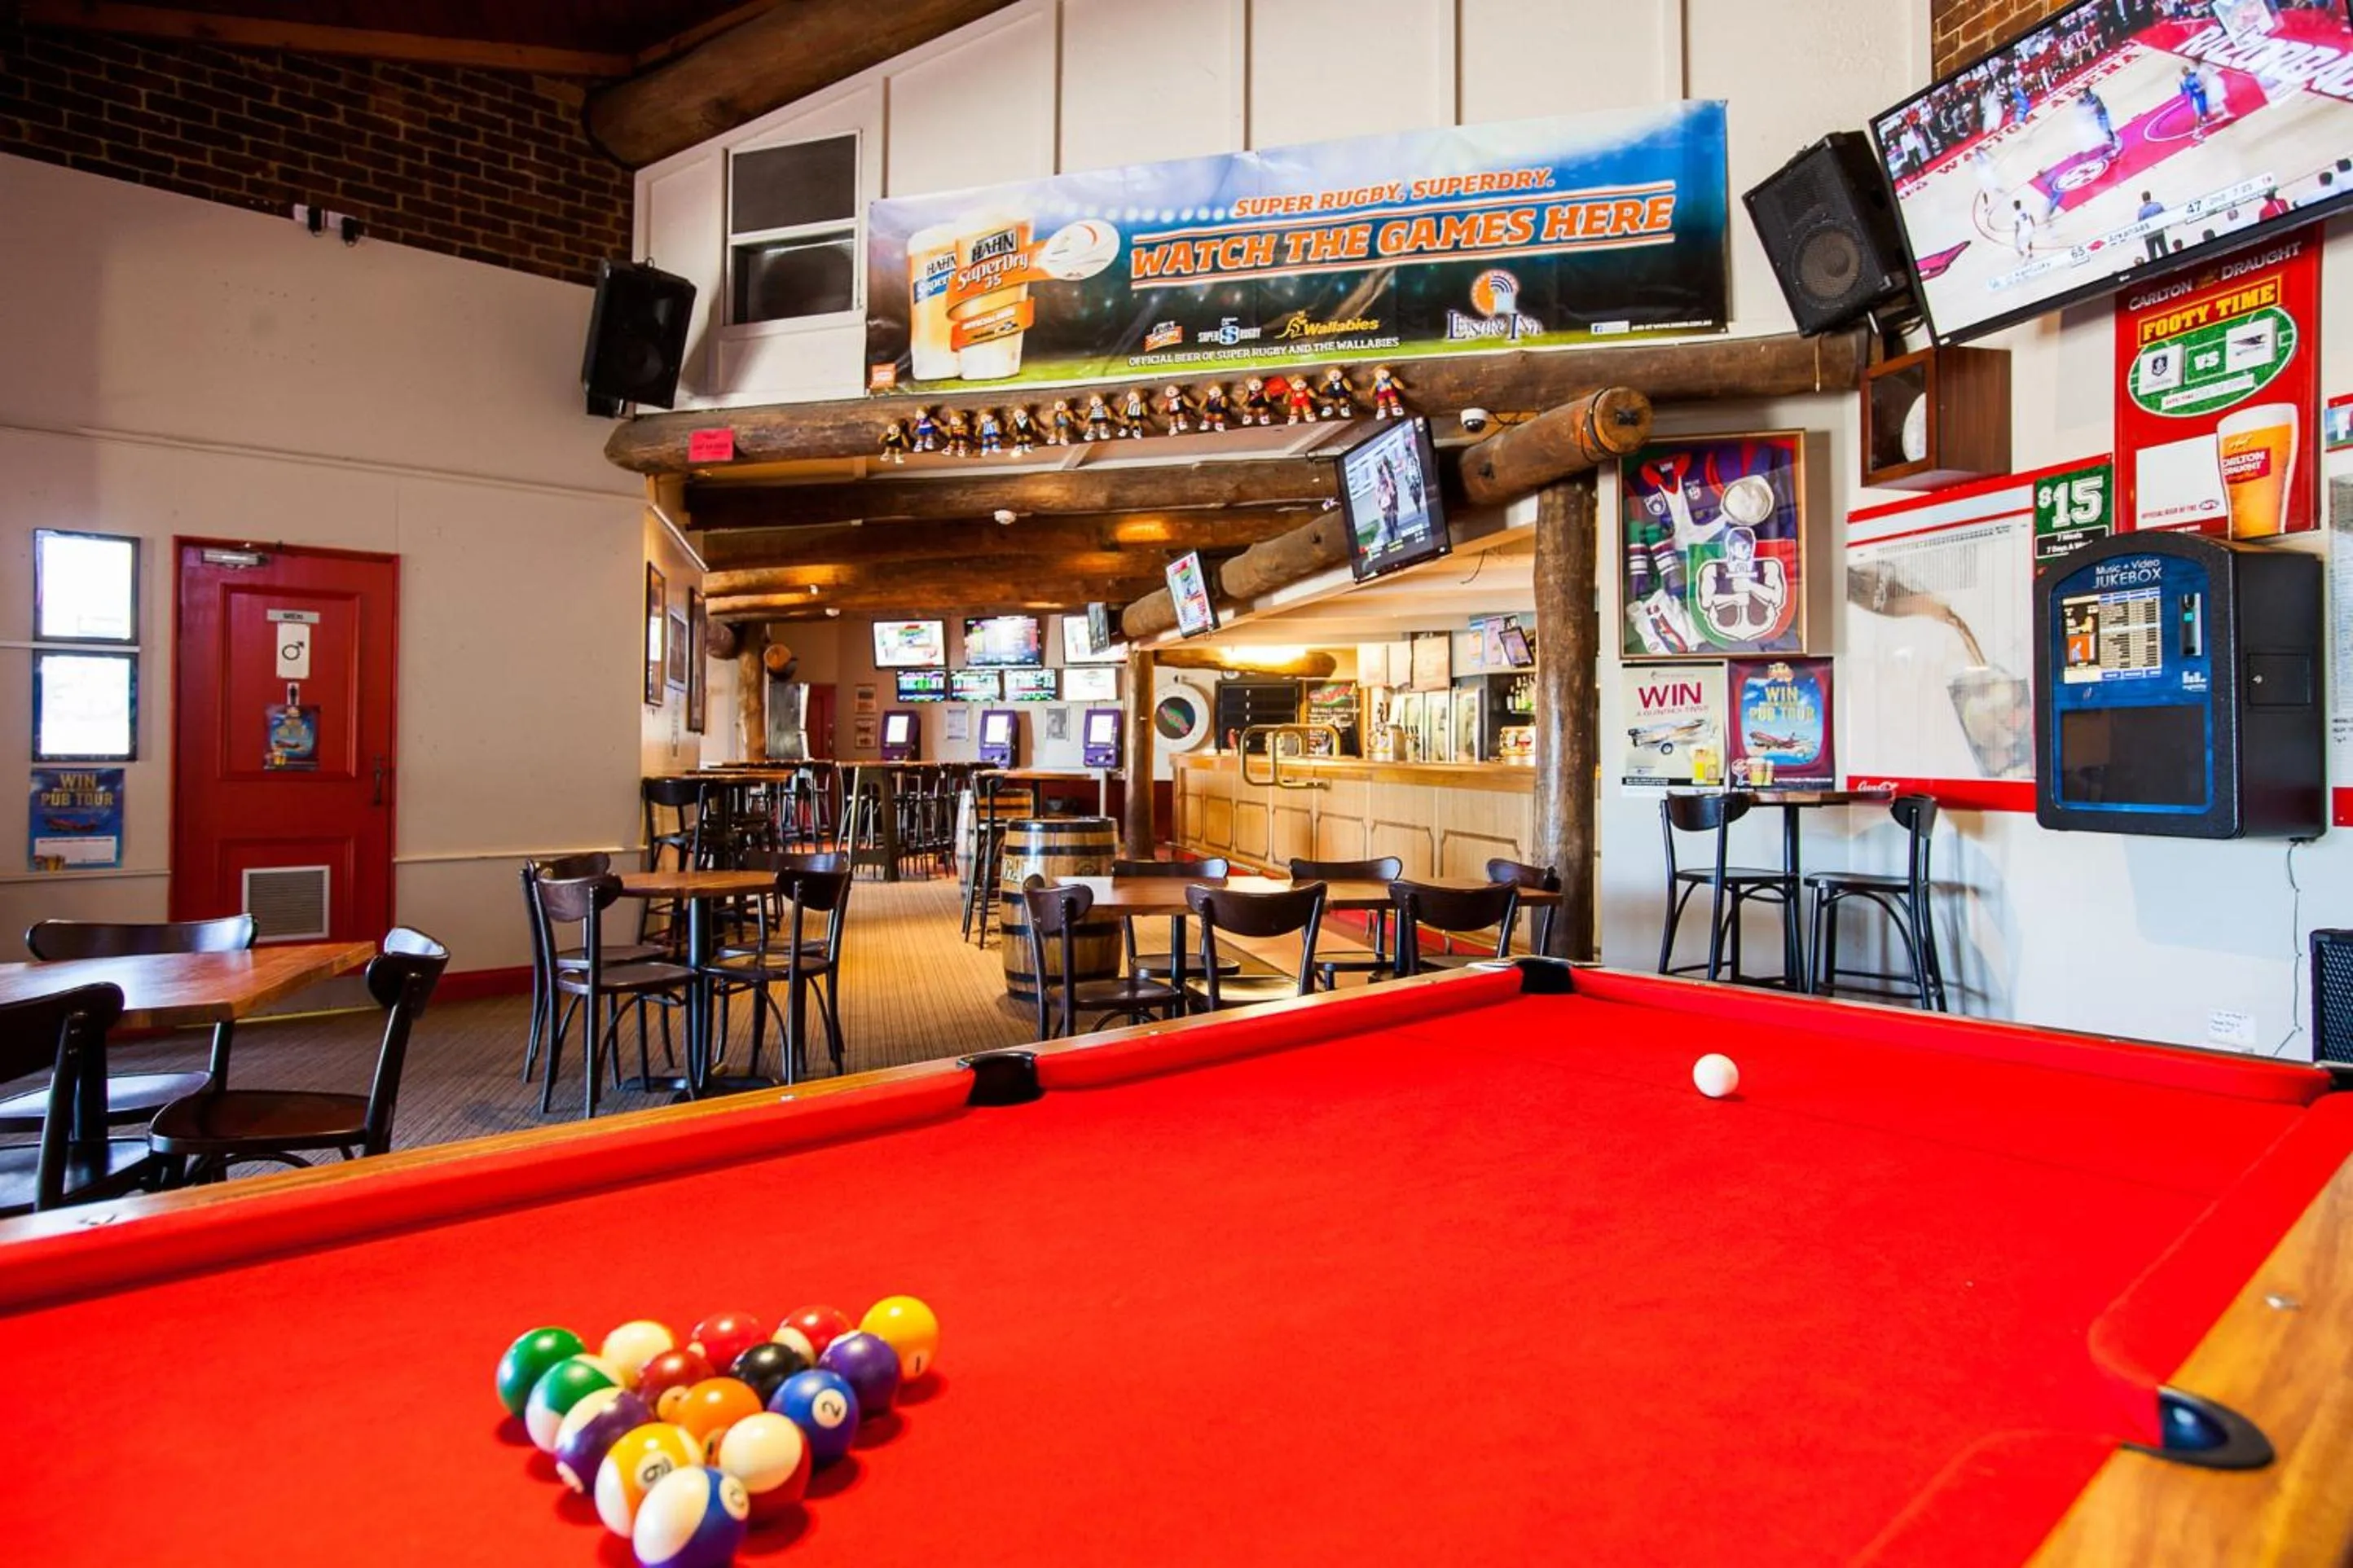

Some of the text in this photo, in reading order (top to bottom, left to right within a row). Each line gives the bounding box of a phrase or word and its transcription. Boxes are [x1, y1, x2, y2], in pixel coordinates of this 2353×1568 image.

[1234, 168, 1555, 218] SUPER RUGBY, SUPERDRY.
[971, 232, 1014, 262] HAHN
[1132, 195, 1675, 279] WATCH THE GAMES HERE
[957, 253, 1029, 292] SuperDry
[2128, 242, 2302, 311] CARLTON DRAUGHT
[2142, 283, 2276, 342] FOOTY TIME
[1304, 318, 1379, 337] Wallabies
[1128, 336, 1401, 367] OFFICIAL BEER OF SUPER RUGBY AND THE WALLABIES
[2038, 475, 2104, 529] $15
[2092, 568, 2162, 589] JUKEBOX
[2095, 564, 2121, 575] Music
[2131, 559, 2161, 569] Video
[1638, 681, 1702, 709] WIN
[1765, 685, 1799, 703] WIN
[59, 773, 97, 791] WIN
[40, 791, 114, 807] PUB TOUR
[820, 1399, 842, 1419] 2
